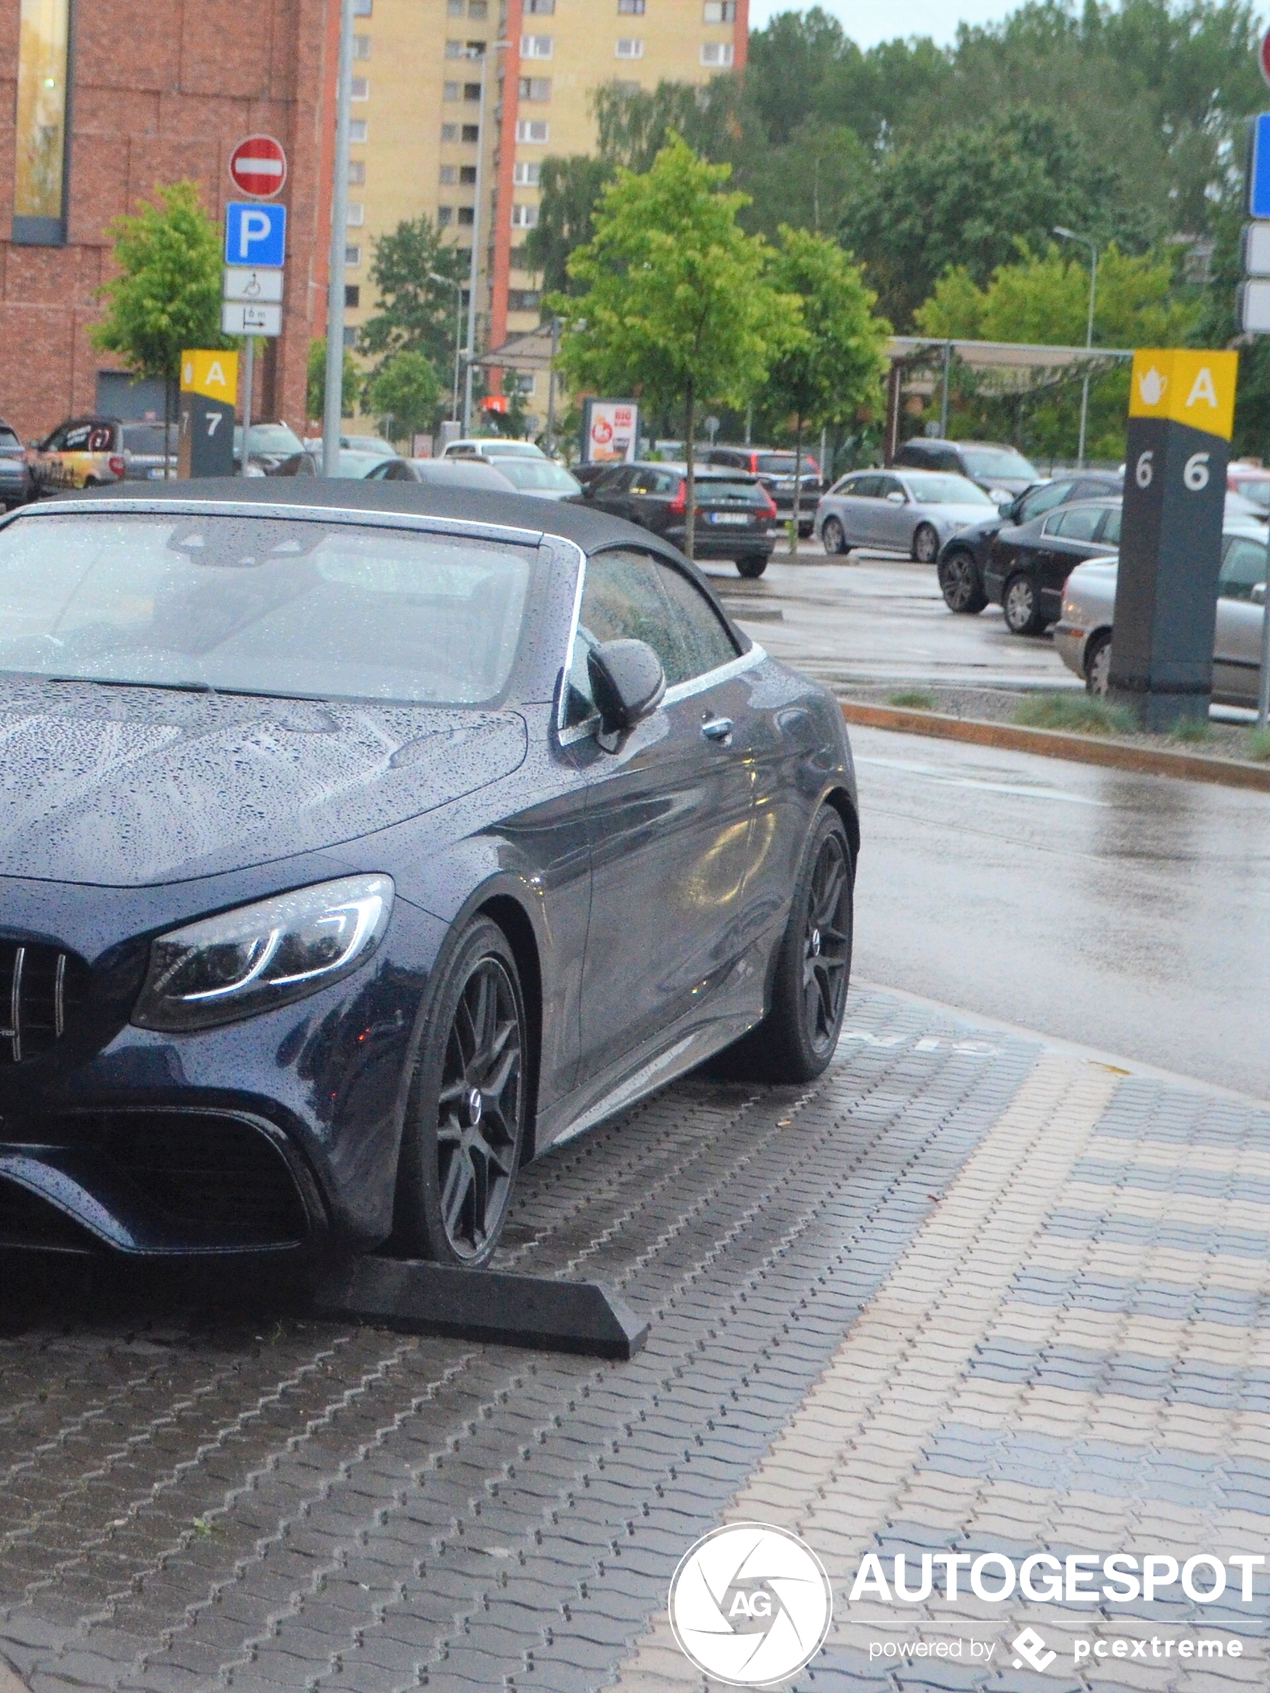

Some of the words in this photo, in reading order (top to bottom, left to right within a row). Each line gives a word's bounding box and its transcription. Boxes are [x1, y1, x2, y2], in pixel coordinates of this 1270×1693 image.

[240, 209, 272, 258] P
[205, 361, 226, 386] A
[1186, 367, 1218, 408] A
[205, 412, 223, 436] 7
[1136, 450, 1153, 489] 6
[1183, 452, 1210, 491] 6
